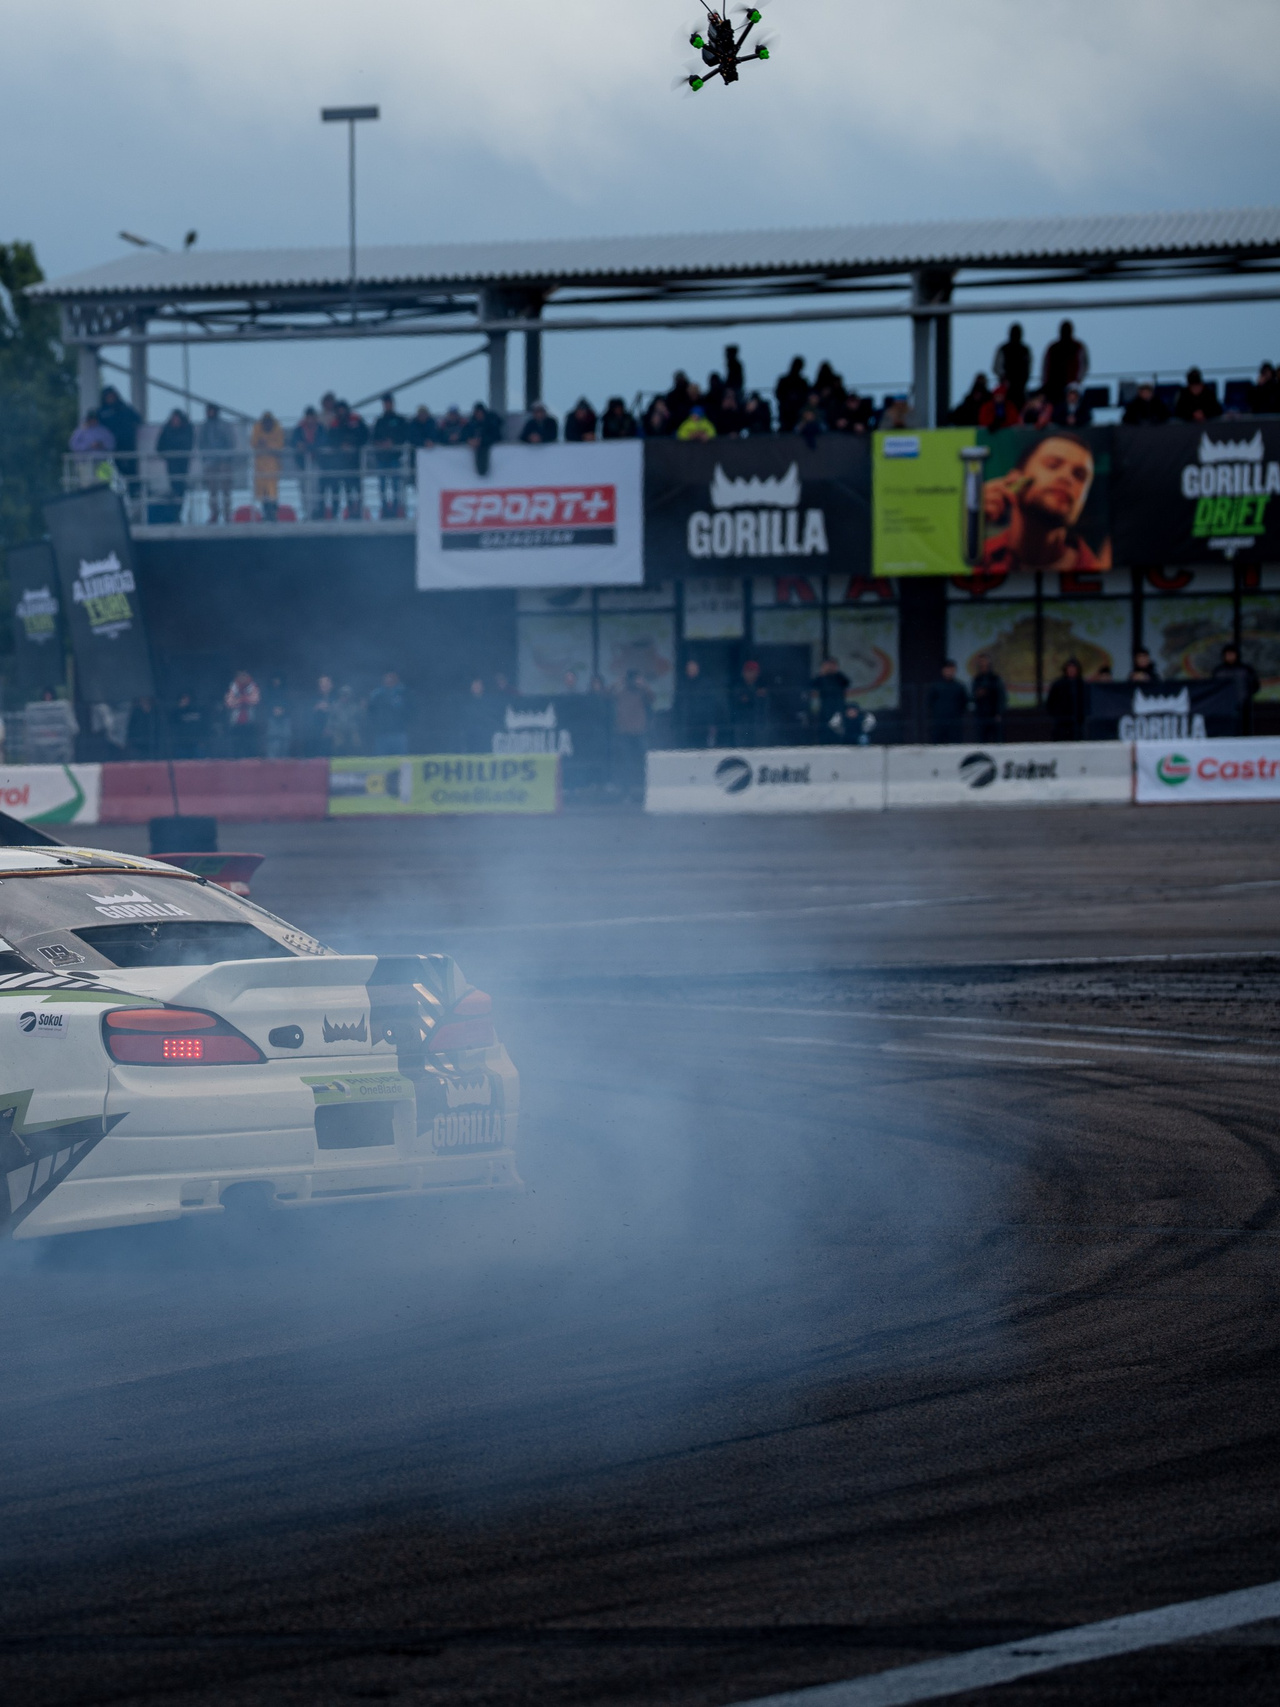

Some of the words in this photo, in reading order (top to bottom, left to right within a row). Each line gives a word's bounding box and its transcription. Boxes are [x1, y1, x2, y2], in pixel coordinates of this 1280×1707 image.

[1182, 461, 1280, 498] GORILLA
[447, 491, 609, 524] SPORT+
[687, 508, 828, 559] GORILLA
[1119, 714, 1207, 741] GORILLA
[423, 760, 537, 783] PHILIPS
[94, 903, 192, 919] GORILLA
[359, 1084, 402, 1096] OneBlade
[433, 1112, 503, 1148] GORILLA
